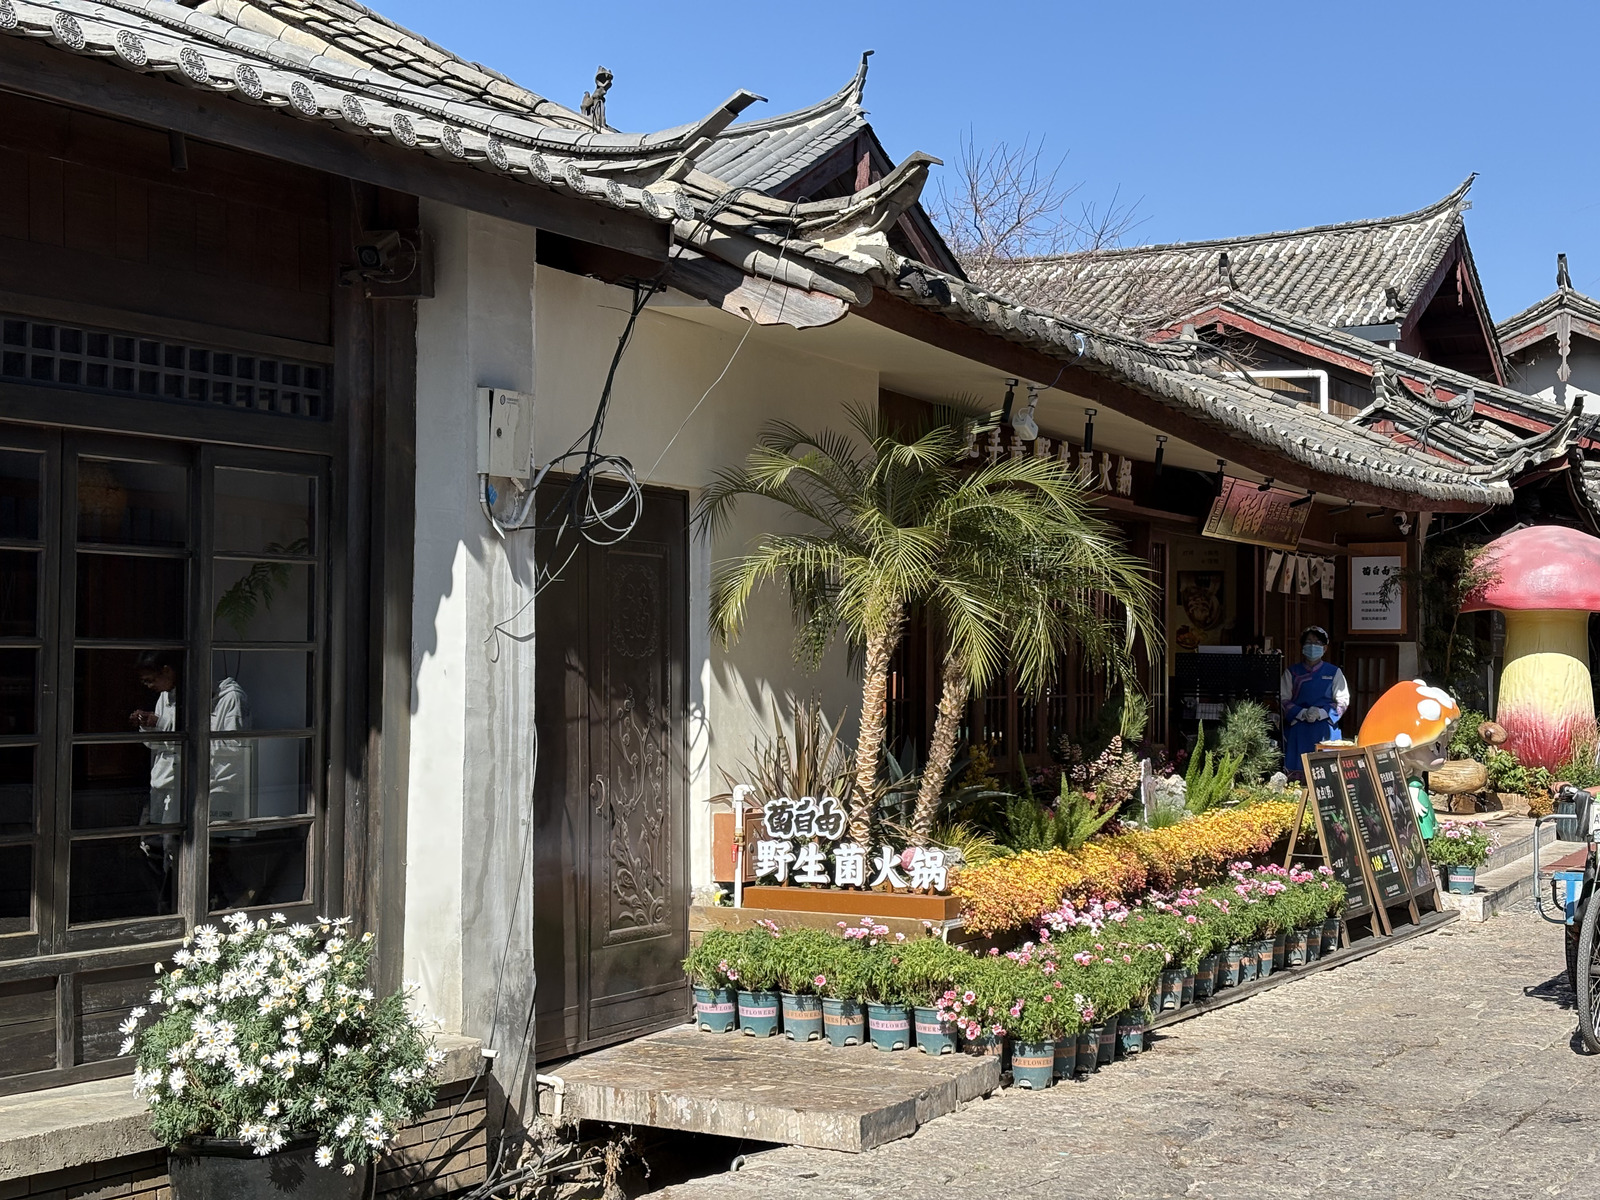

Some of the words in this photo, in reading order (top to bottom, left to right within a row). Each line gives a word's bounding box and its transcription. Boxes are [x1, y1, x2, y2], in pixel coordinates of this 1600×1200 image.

[765, 798, 846, 839] 菌自由
[756, 840, 947, 891] 野生菌火锅
